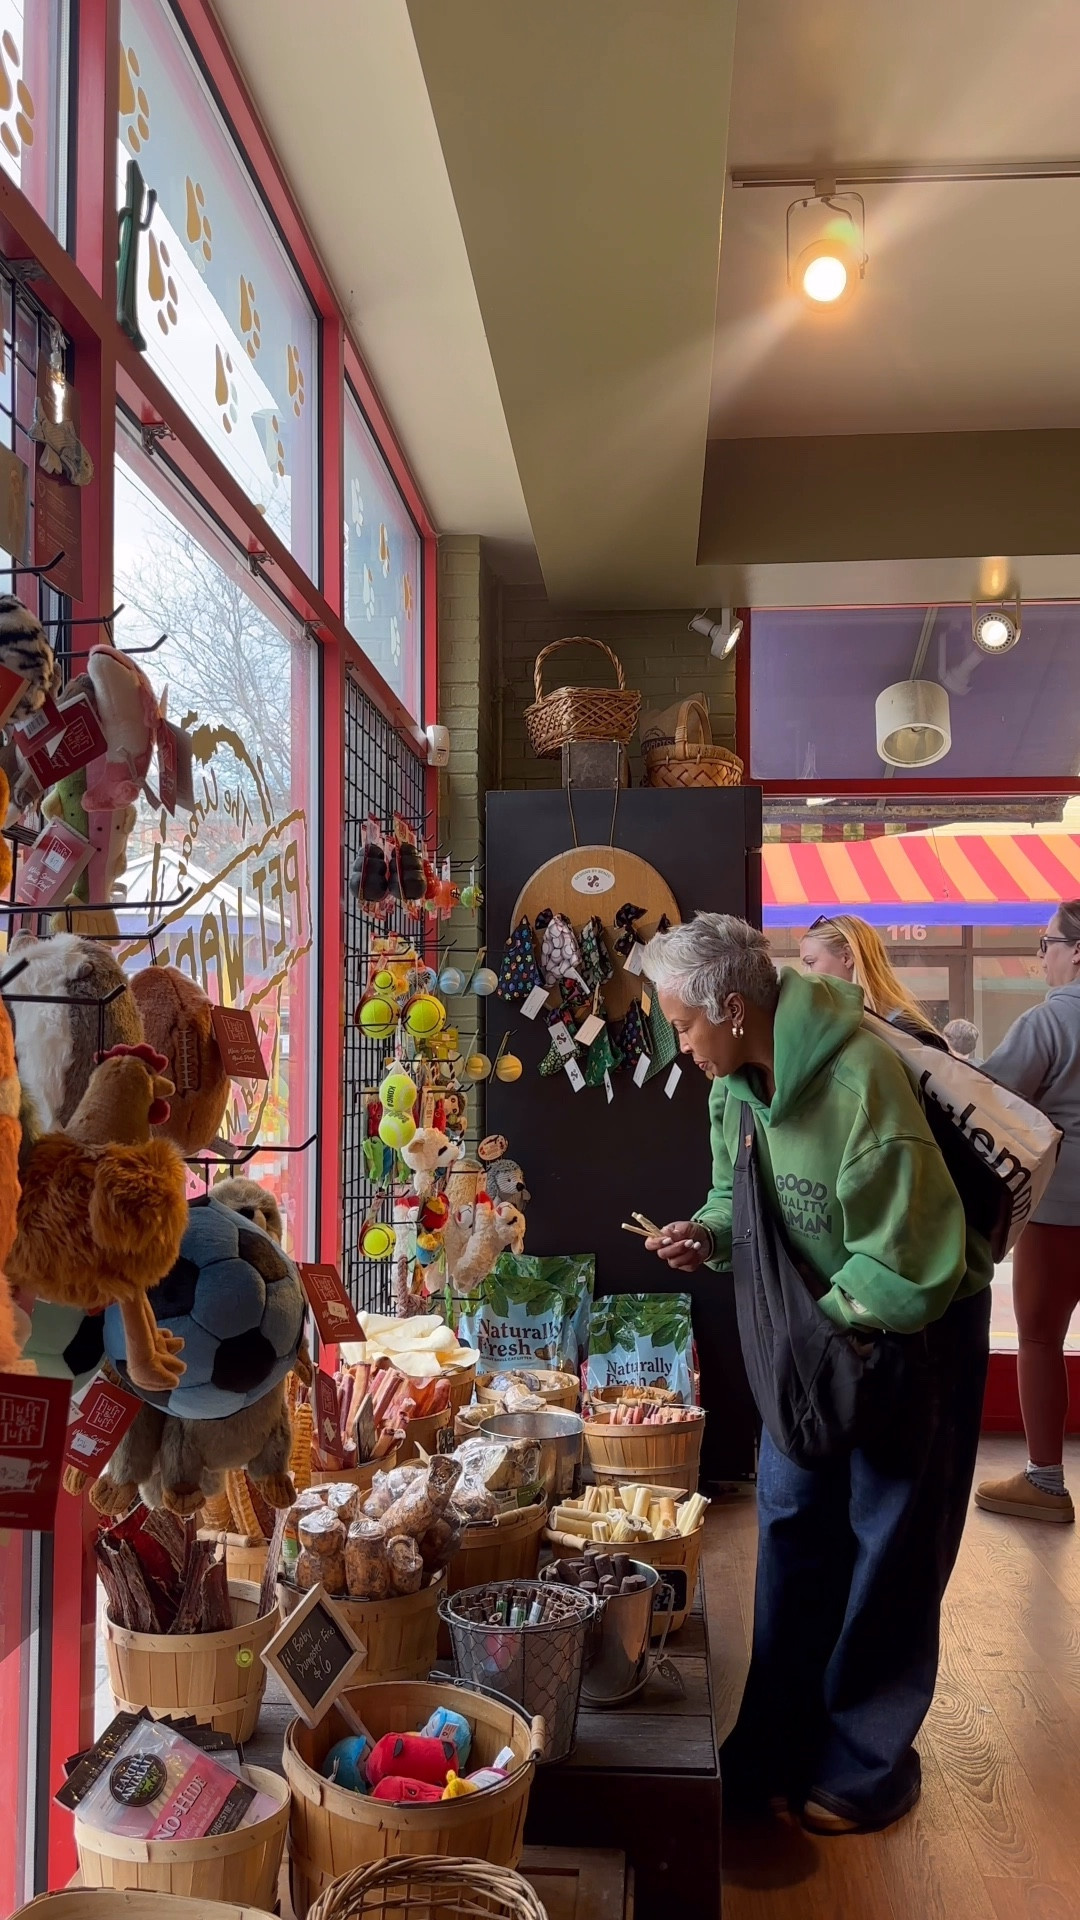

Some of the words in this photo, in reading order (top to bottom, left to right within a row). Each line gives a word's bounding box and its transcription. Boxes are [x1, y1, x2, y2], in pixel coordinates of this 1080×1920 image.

[887, 924, 927, 941] 116
[387, 1085, 396, 1104] KONG
[776, 1173, 828, 1201] GOOD
[782, 1208, 832, 1234] UMAN
[478, 1318, 563, 1340] Naturally
[477, 1335, 532, 1357] Fresh
[606, 1356, 673, 1377] Naturally
[91, 1411, 115, 1429] Tuff
[97, 1398, 123, 1419] Fluff
[292, 1628, 313, 1652] Baby
[296, 1639, 322, 1678] Dumpster
[313, 1655, 332, 1680] $6
[114, 1756, 143, 1793] EARTH
[121, 1759, 154, 1801] ANIMAL
